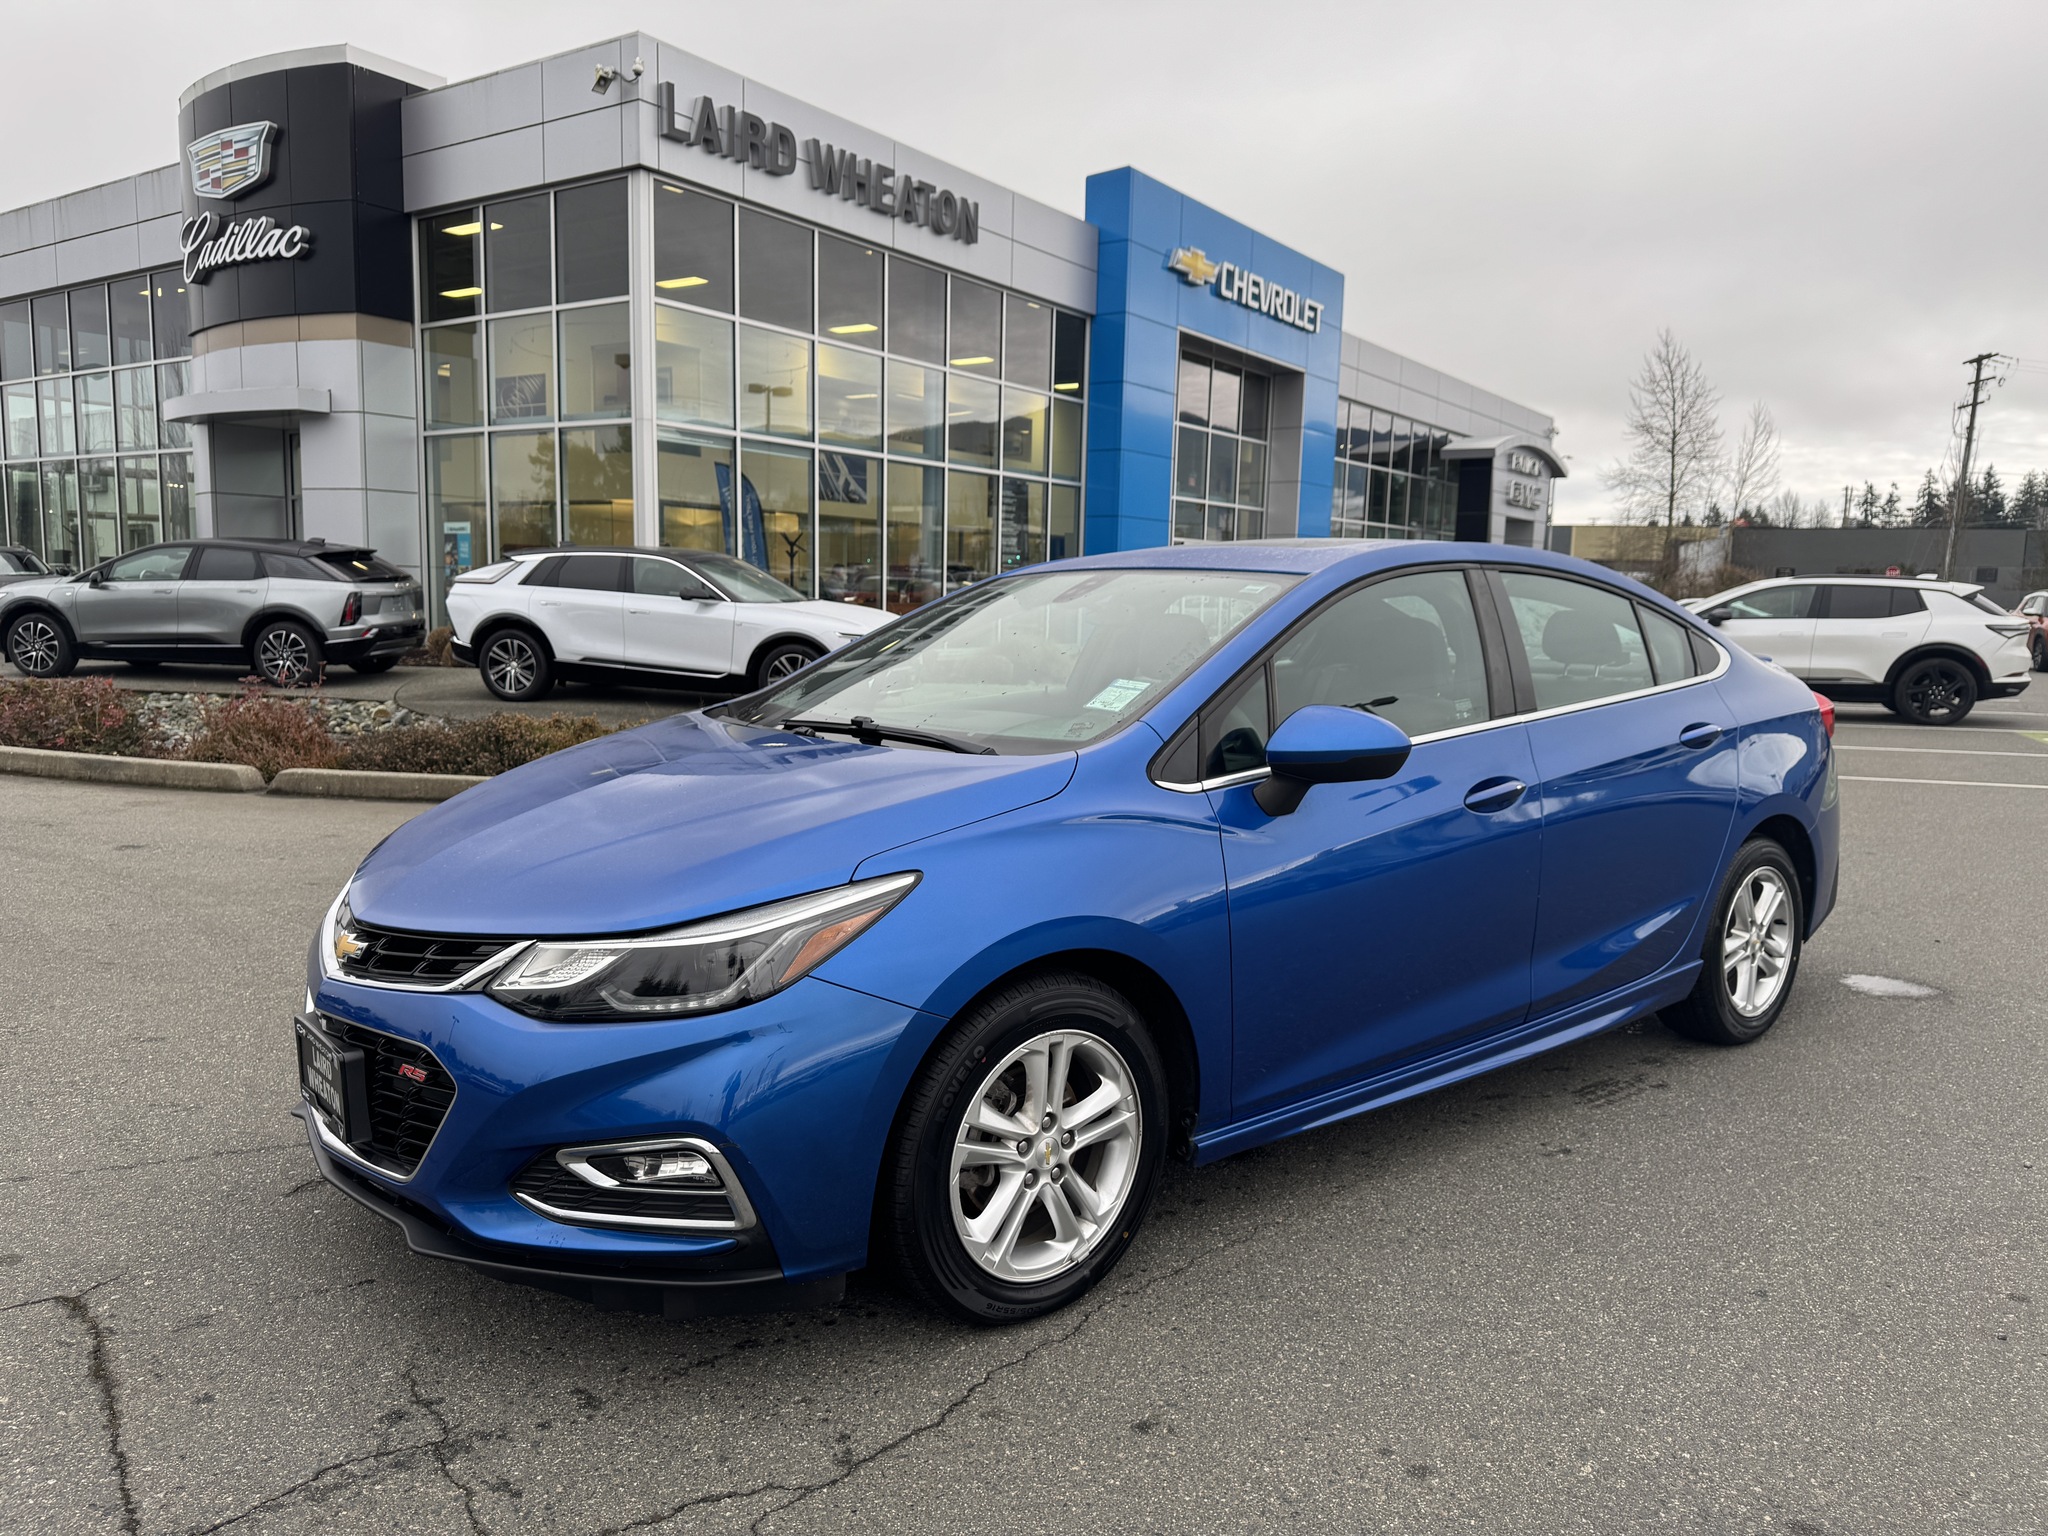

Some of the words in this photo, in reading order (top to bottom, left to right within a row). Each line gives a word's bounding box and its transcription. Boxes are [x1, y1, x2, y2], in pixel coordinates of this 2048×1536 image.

[658, 81, 797, 176] LAIRD
[804, 137, 980, 245] WHEATON
[179, 210, 309, 285] Cadillac
[1220, 260, 1325, 335] CHEVROLET
[1507, 480, 1541, 510] GMC
[306, 1064, 342, 1116] WHEATON
[312, 1045, 332, 1081] LAIRD
[398, 1063, 428, 1082] RS
[935, 1045, 985, 1123] ROVELO
